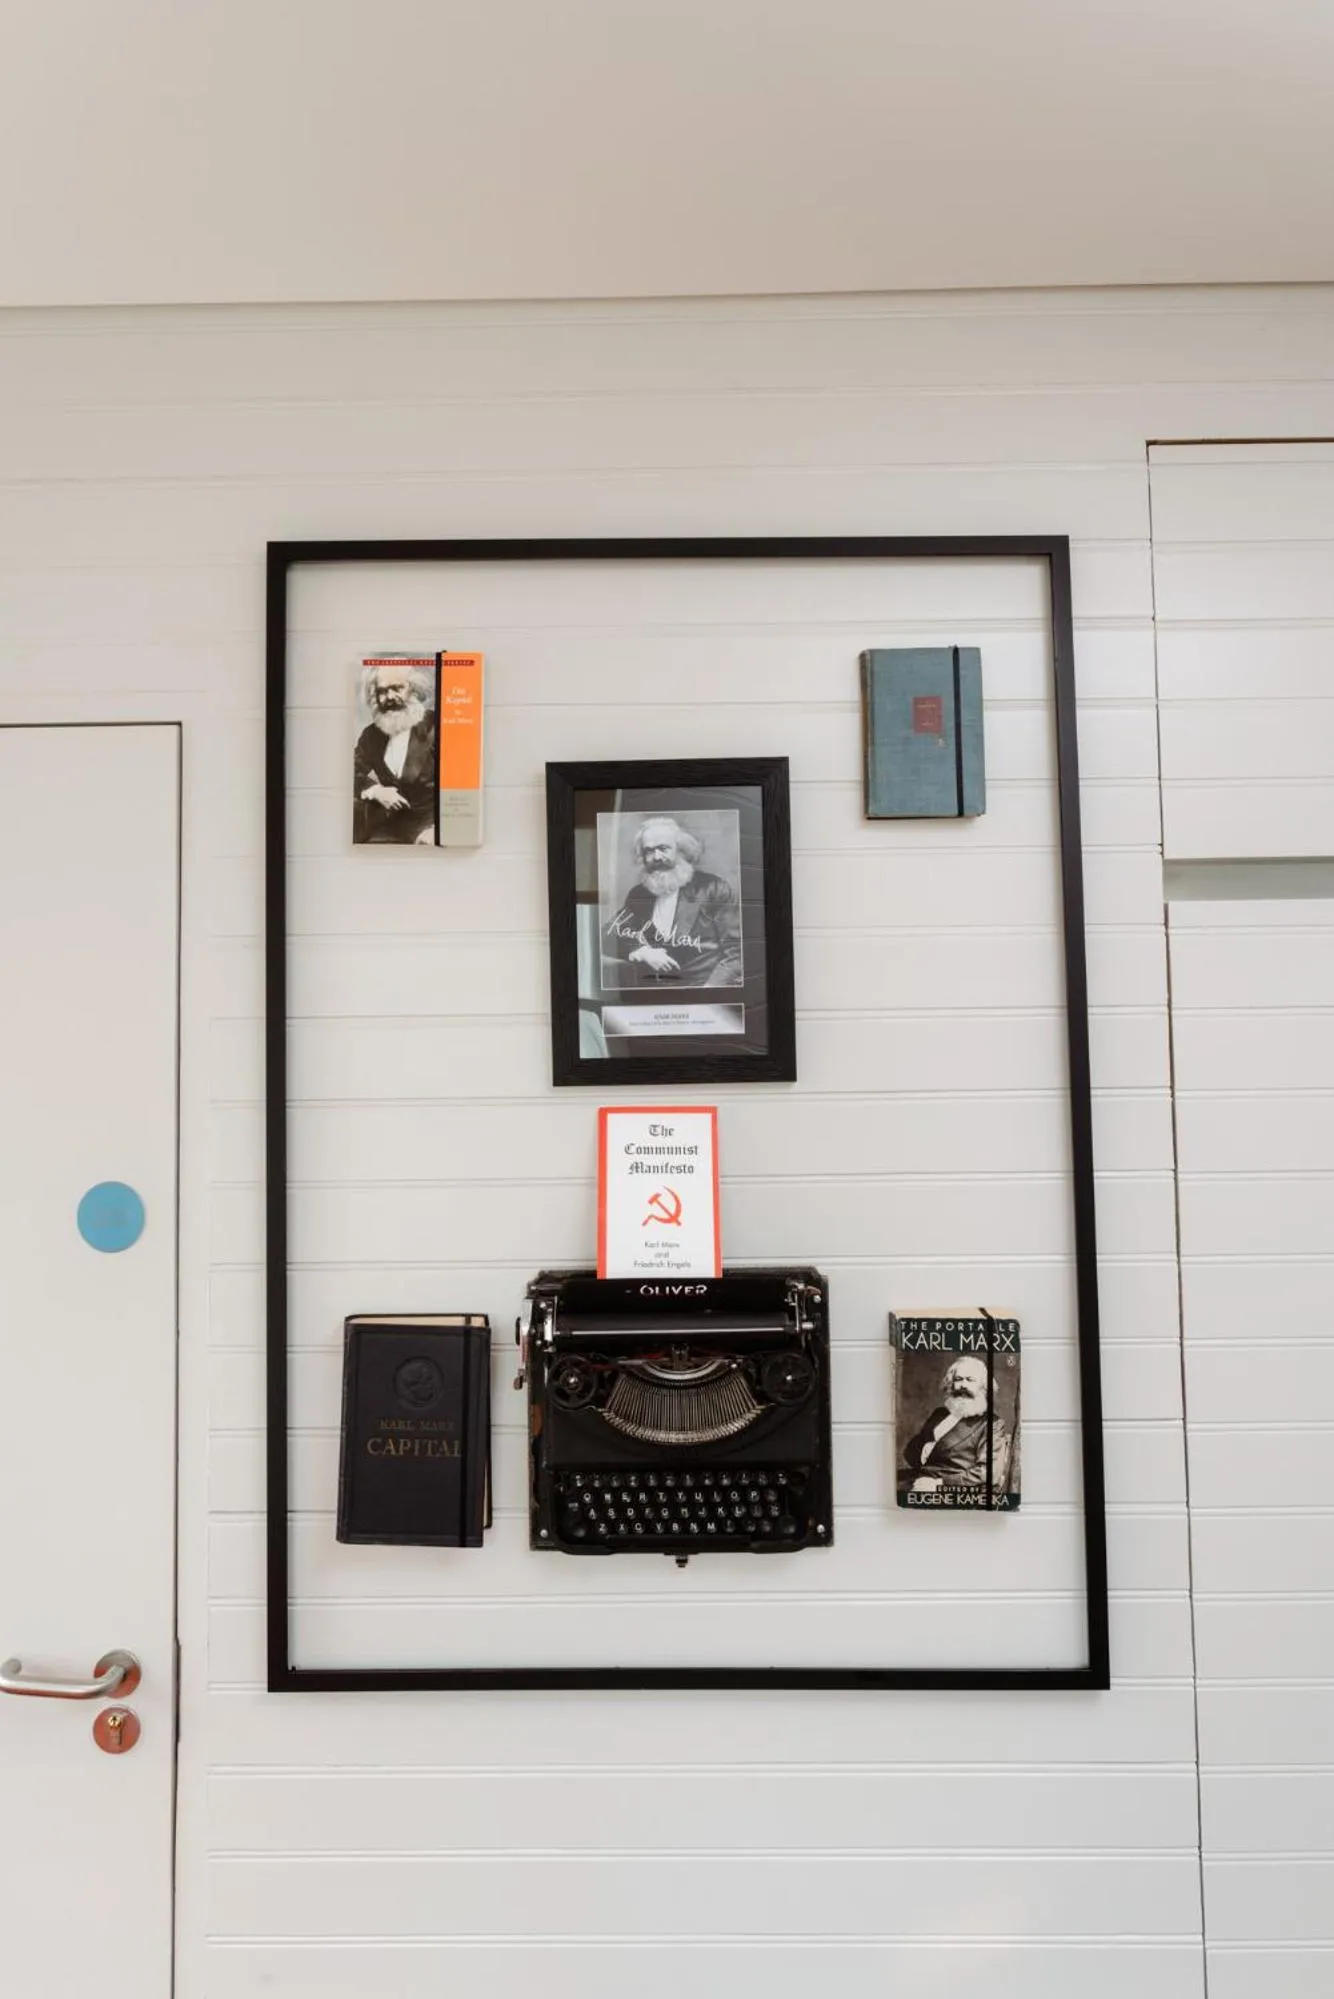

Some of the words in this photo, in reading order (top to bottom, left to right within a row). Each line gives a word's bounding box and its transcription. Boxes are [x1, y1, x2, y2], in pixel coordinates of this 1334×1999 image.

[607, 908, 651, 947] Karl
[648, 1124, 675, 1137] The
[624, 1143, 698, 1156] Communist
[628, 1161, 694, 1175] Manifesto
[644, 1240, 659, 1248] Karl
[654, 1250, 670, 1258] and
[633, 1260, 664, 1268] Friedrich
[667, 1260, 691, 1269] Engels
[640, 1284, 708, 1296] OLIVER
[900, 1321, 928, 1331] THE
[936, 1321, 1015, 1332] PORTALE
[901, 1331, 953, 1350] KARL
[960, 1332, 1015, 1352] MARX
[379, 1418, 413, 1431] KARL
[366, 1437, 462, 1458] CAPITAL
[907, 1493, 954, 1505] EUGENE
[957, 1494, 1010, 1506] KAMEKA
